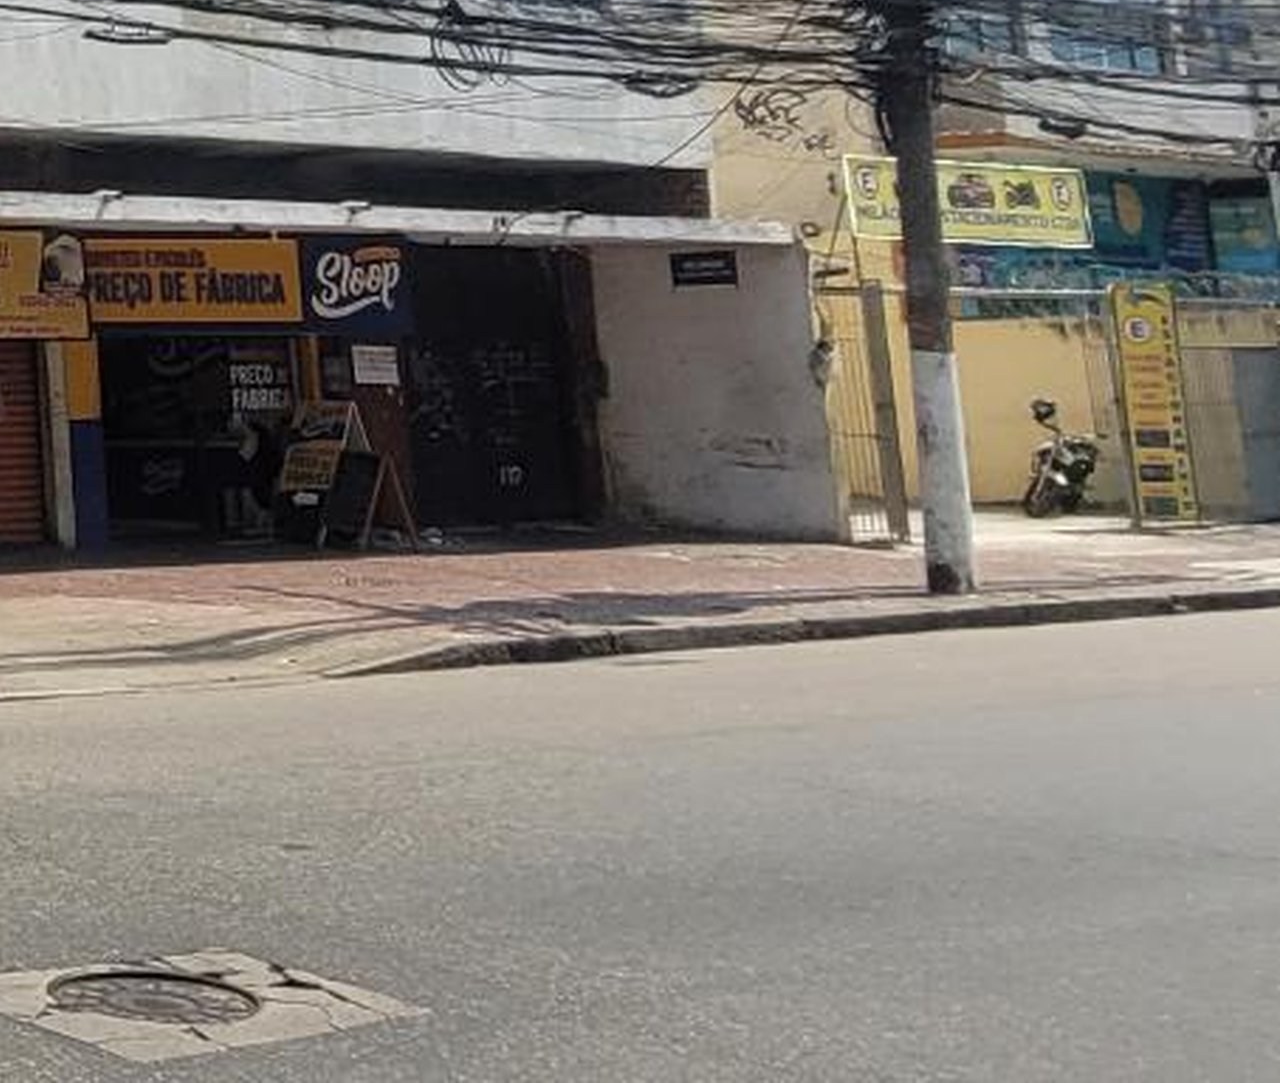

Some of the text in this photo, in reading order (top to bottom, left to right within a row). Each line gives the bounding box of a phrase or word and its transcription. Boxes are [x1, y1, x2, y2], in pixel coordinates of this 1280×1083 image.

[159, 271, 188, 303] DE
[194, 267, 286, 305] FÁBRICA
[312, 250, 400, 318] Sloop
